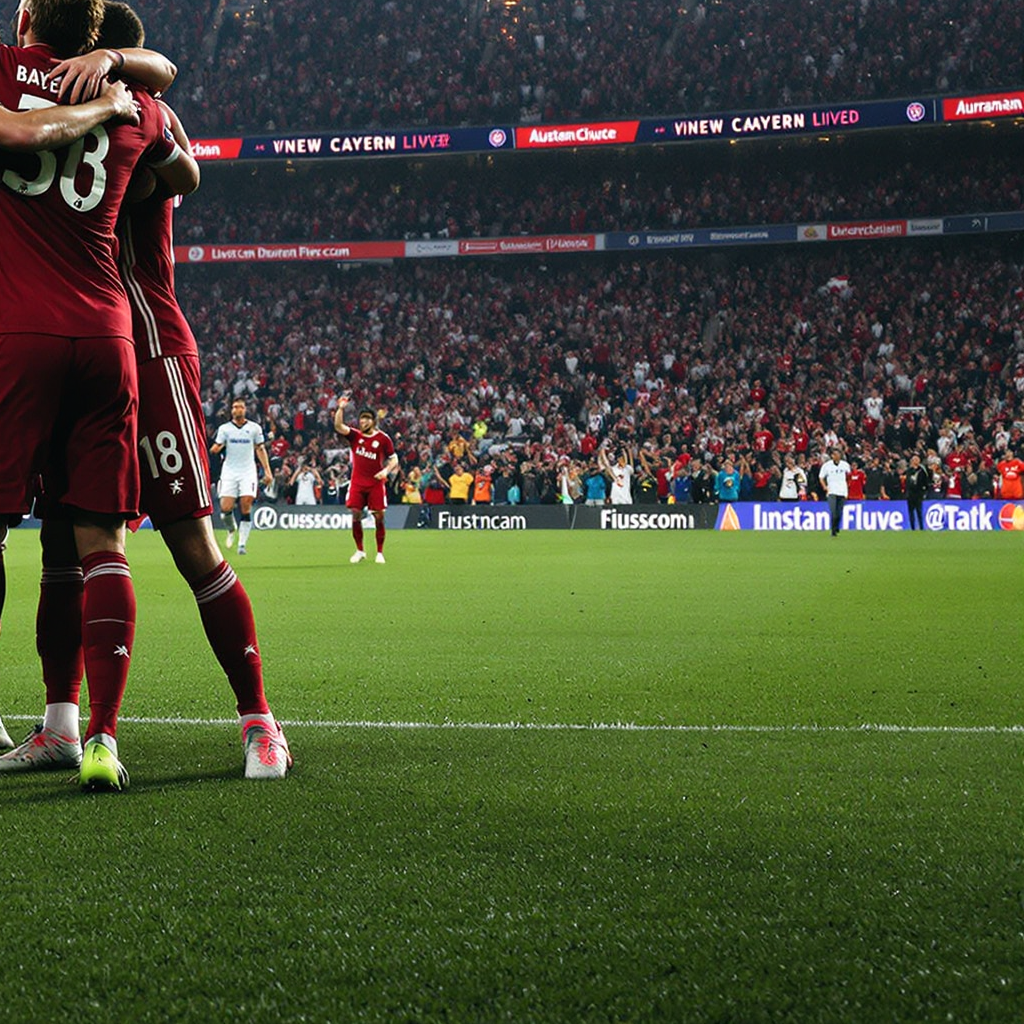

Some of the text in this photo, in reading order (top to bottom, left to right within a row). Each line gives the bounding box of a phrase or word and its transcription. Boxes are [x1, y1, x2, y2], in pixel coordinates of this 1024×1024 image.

[330, 135, 396, 153] CAYERN
[139, 430, 183, 479] 18
[842, 503, 904, 531] Fluve
